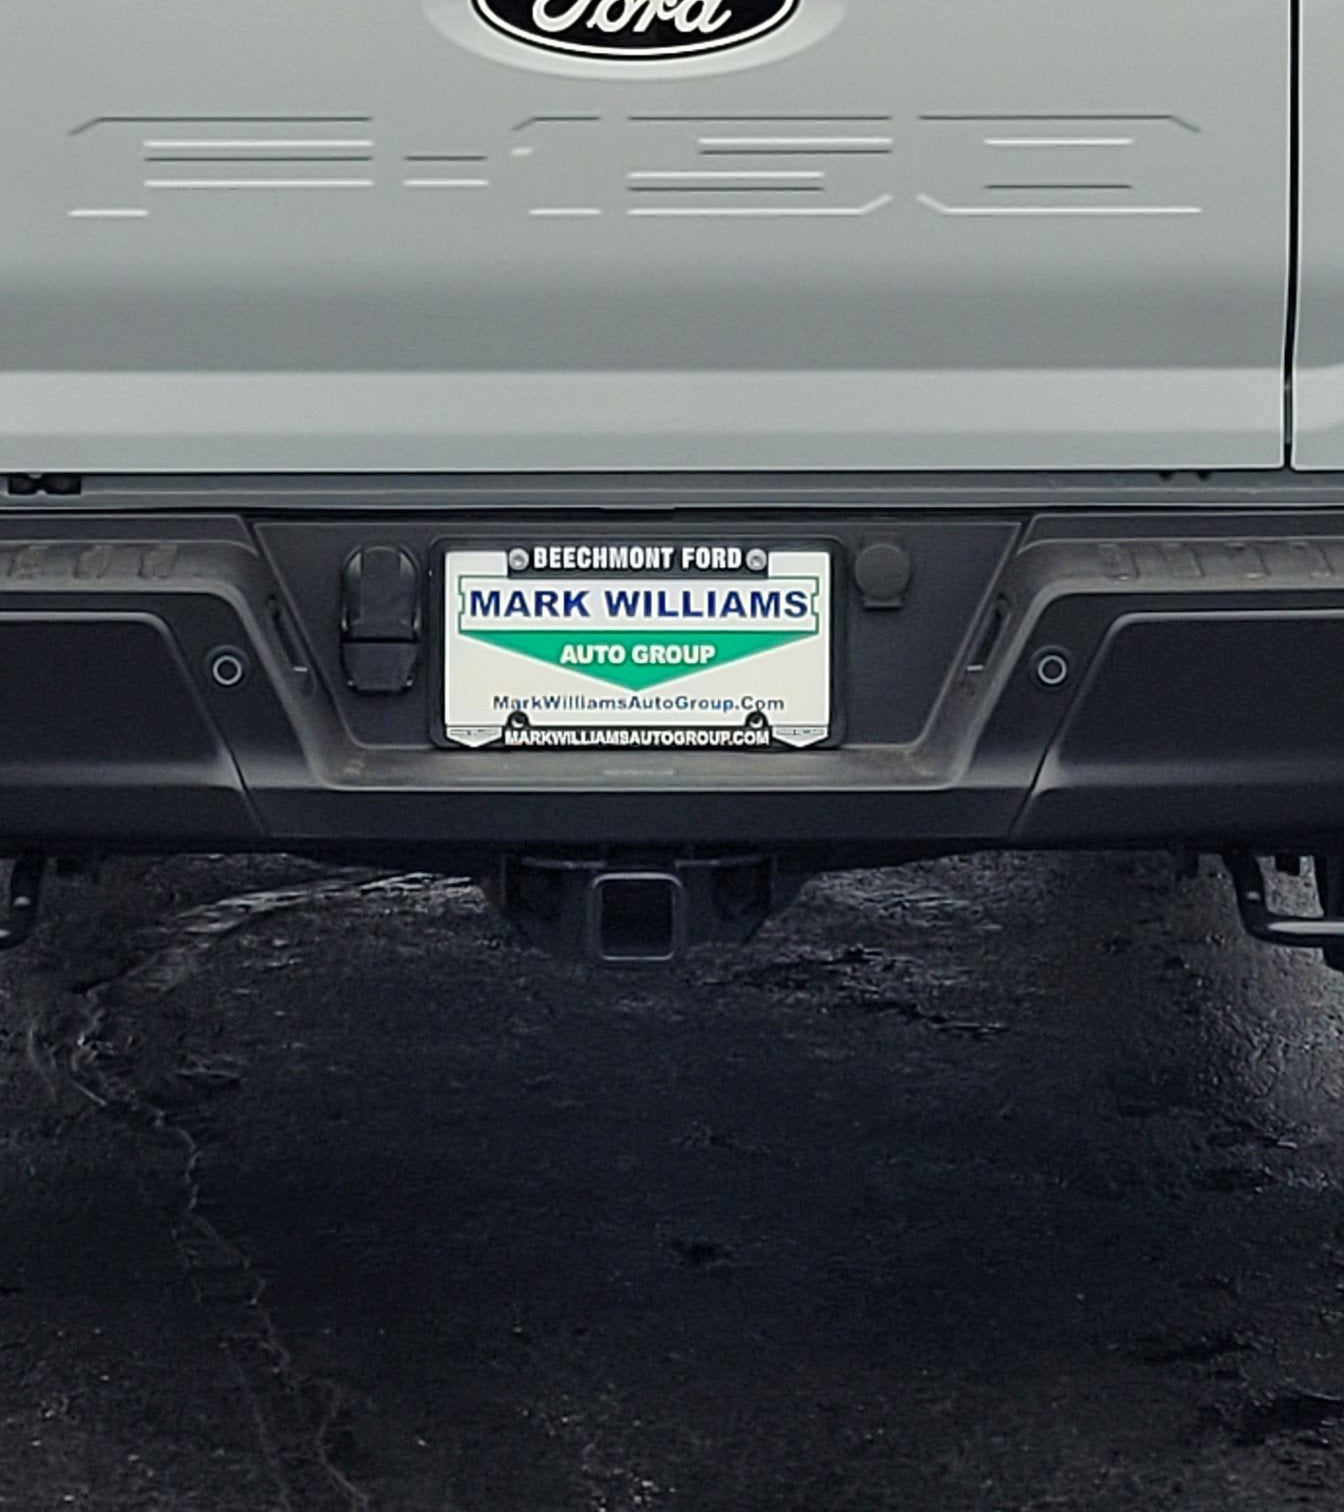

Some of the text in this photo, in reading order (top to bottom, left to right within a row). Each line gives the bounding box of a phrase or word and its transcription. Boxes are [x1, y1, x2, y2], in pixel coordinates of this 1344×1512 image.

[67, 115, 1202, 216] F-150
[533, 546, 743, 569] BEECHMONT FORD
[469, 590, 809, 618] MARK WILLIAMS
[559, 644, 716, 665] AUTO GROUP
[493, 694, 785, 713] MarkWilliamsAutoGroup.Com
[504, 729, 771, 746] MARKWILLIAMSAUTOGROUP.COM
